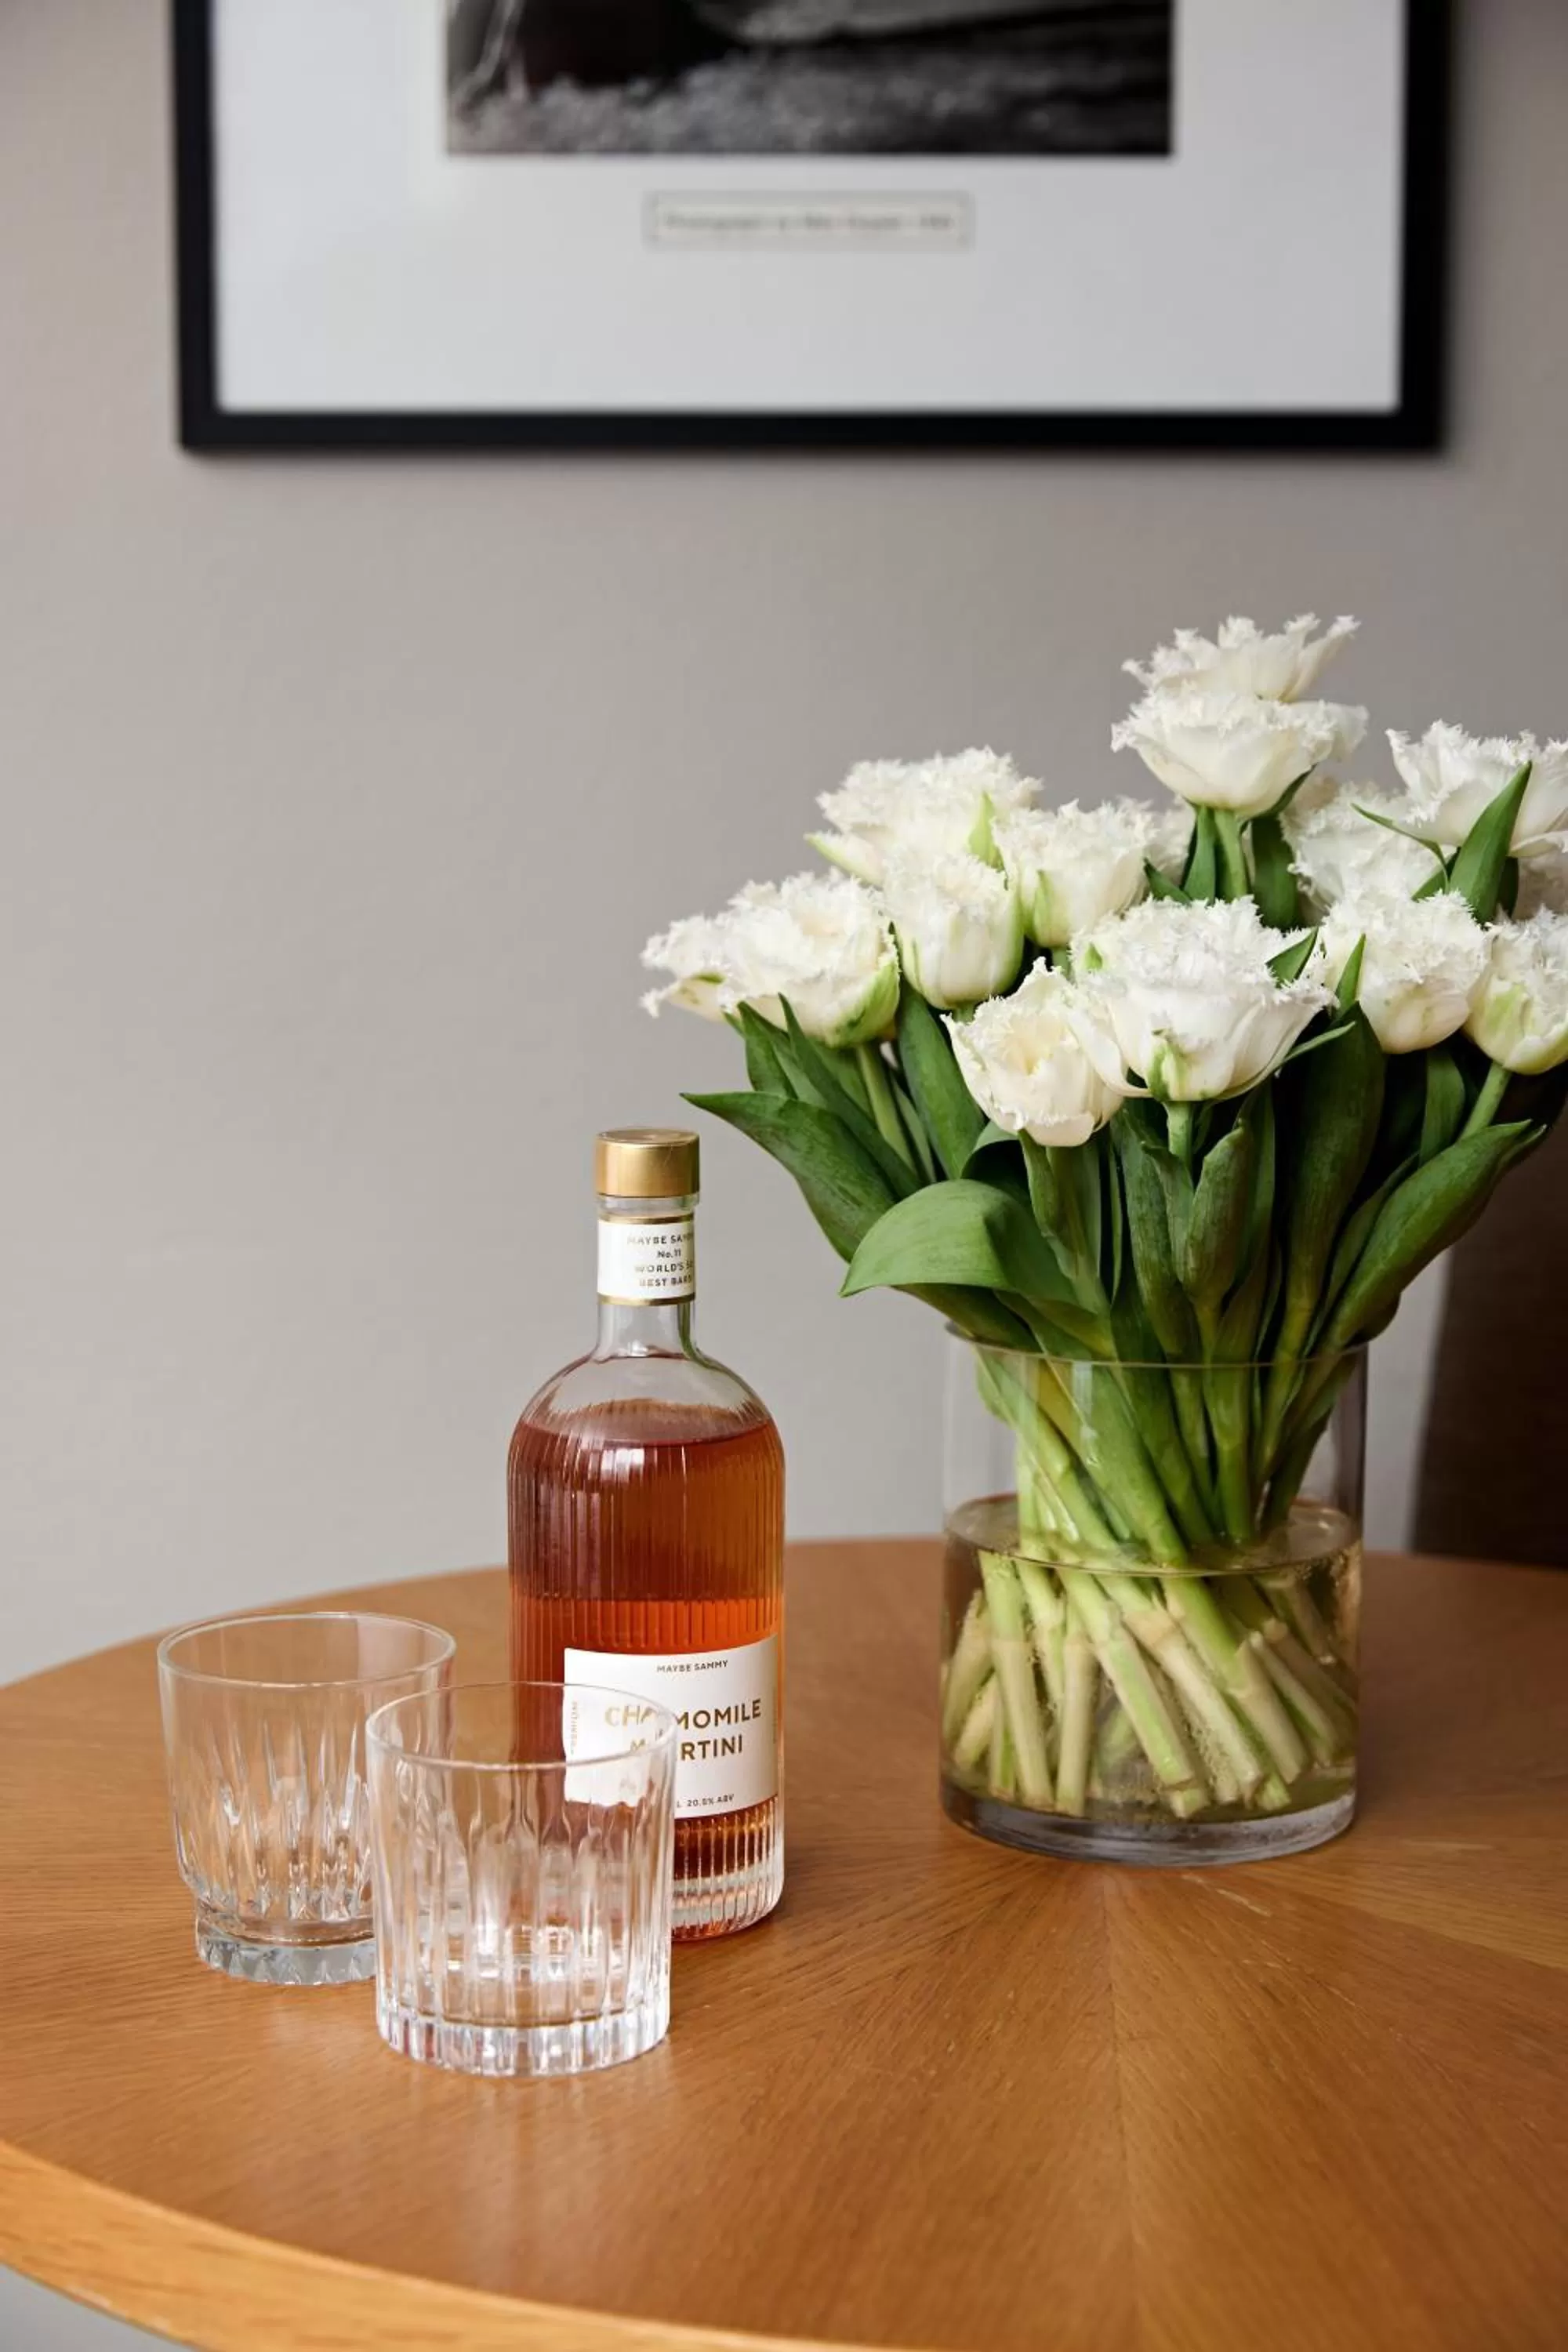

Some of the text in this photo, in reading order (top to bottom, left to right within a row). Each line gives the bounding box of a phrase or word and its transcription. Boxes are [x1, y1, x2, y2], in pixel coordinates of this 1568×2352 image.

[627, 1236, 667, 1245] MAYBE
[639, 1278, 667, 1287] BEST
[656, 1660, 729, 1673] MAYBE SAMMY
[630, 1734, 743, 1762] MRTINI
[717, 1793, 735, 1802] ABV
